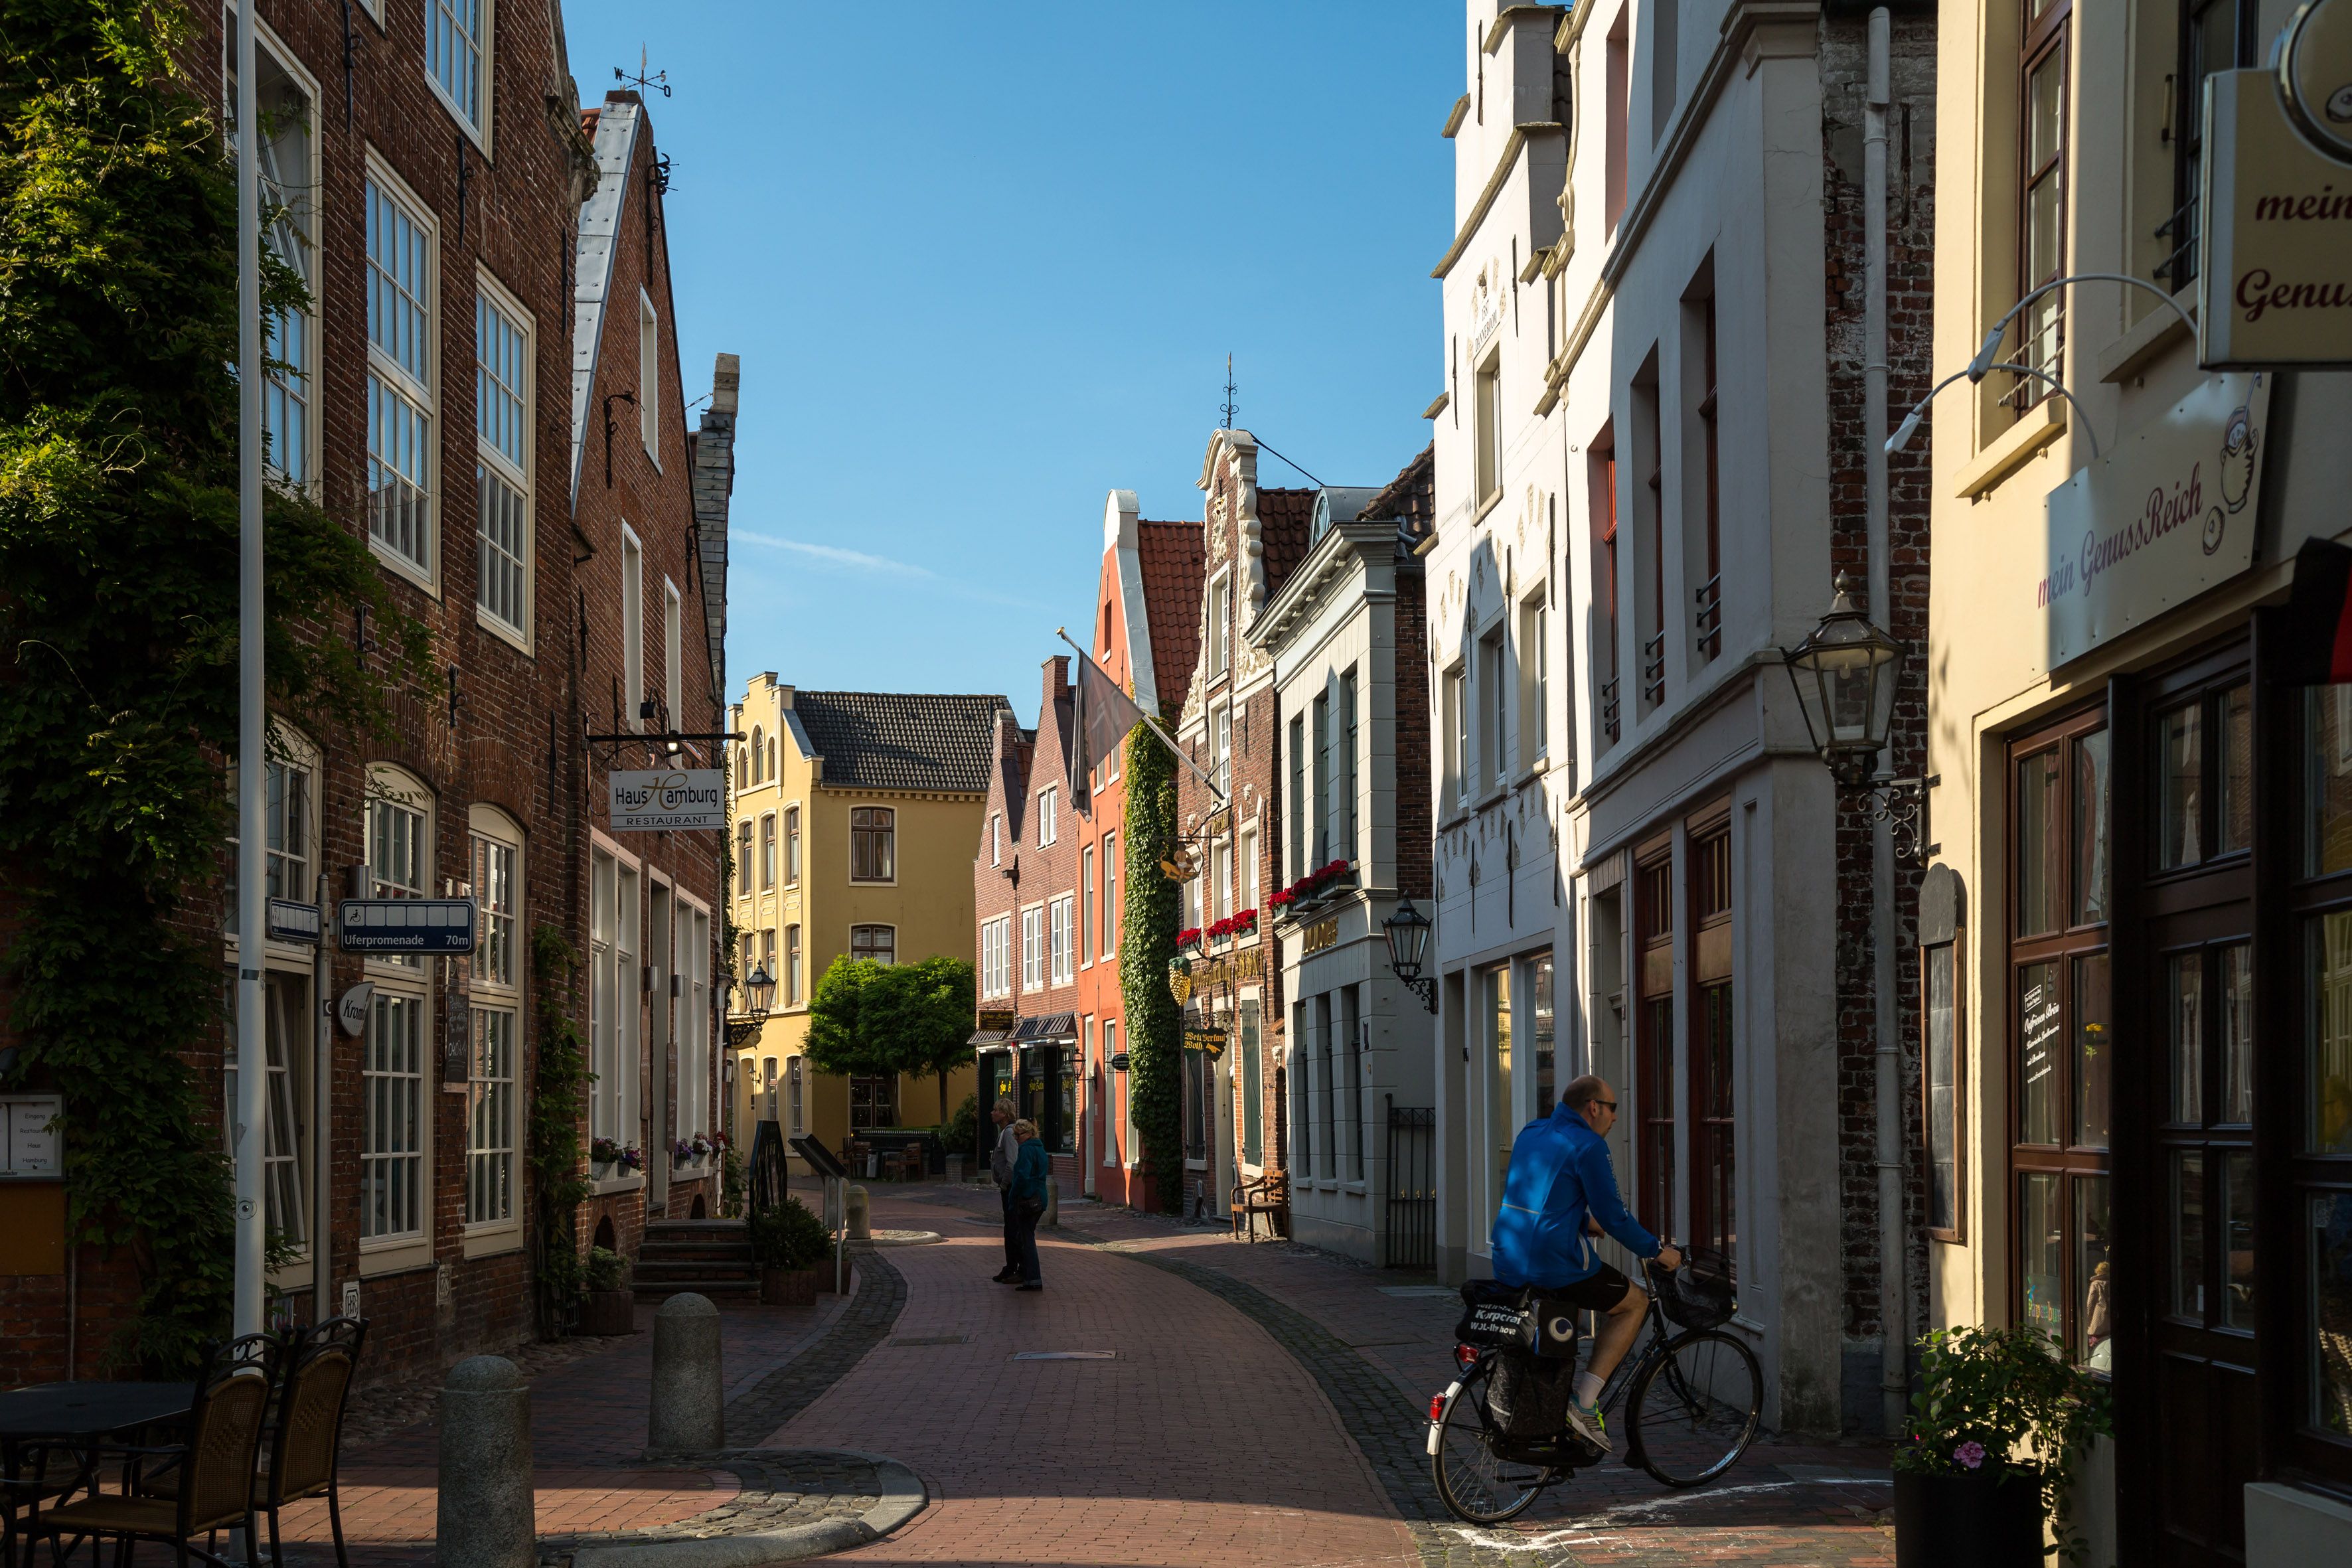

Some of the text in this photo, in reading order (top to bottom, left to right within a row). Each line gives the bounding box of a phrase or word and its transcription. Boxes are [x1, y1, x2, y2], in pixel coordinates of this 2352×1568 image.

[2037, 461, 2203, 609] mein GenussReich
[615, 773, 718, 811] Haus Hamburg
[627, 816, 708, 826] RESTAURANT
[345, 934, 469, 946] Uferpromenade 70m
